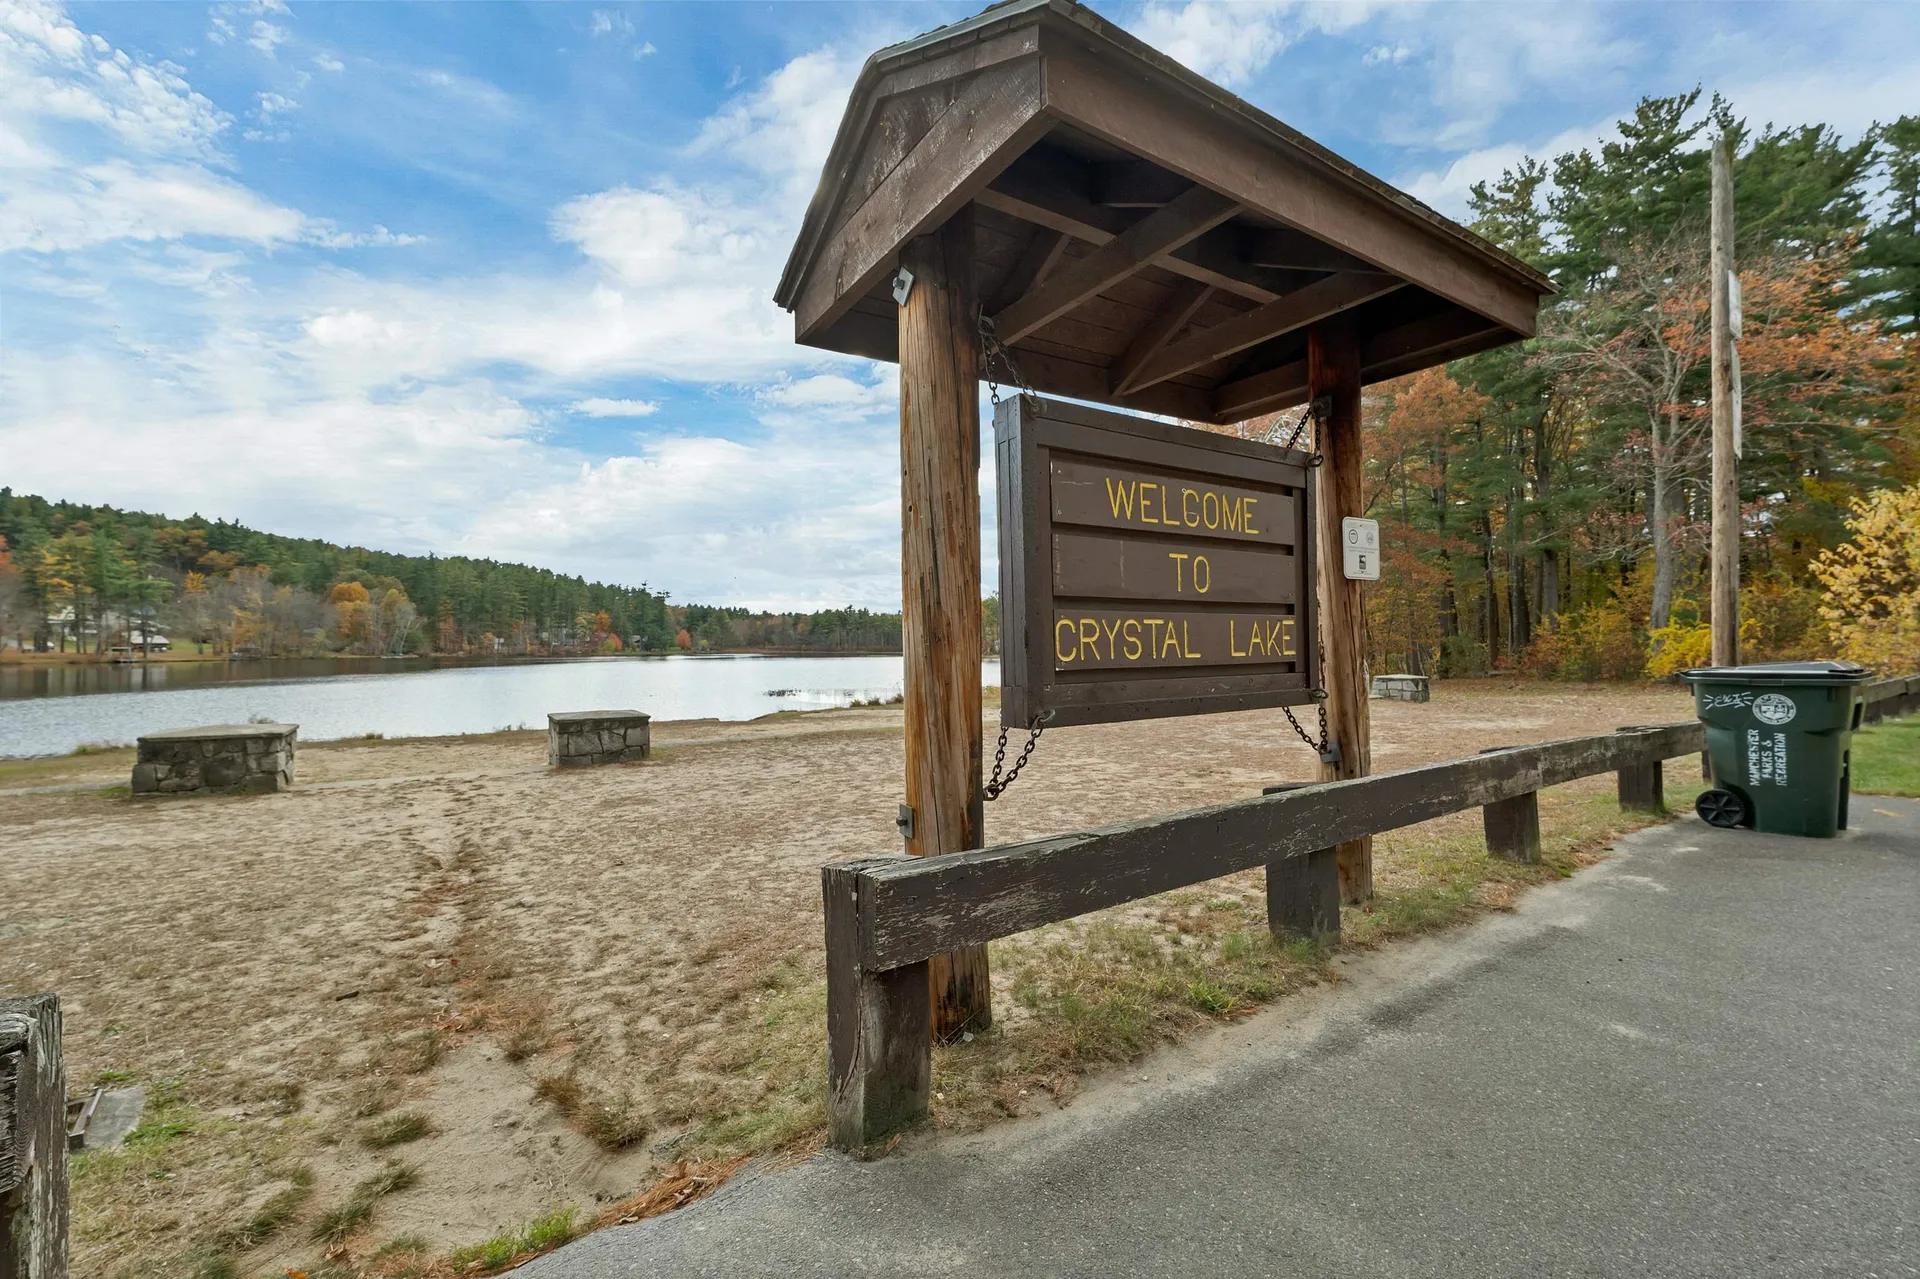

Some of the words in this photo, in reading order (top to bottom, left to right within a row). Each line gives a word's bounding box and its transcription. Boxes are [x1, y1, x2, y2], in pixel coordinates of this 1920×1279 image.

[1106, 477, 1259, 534] WELCOME
[1169, 553, 1211, 593] TO
[1055, 618, 1201, 662] CRYSTAL
[1230, 618, 1296, 658] LAKE
[1747, 728, 1760, 786] MANCHESTER
[1761, 750, 1773, 779] PARKS
[1774, 732, 1788, 786] RECREATION
